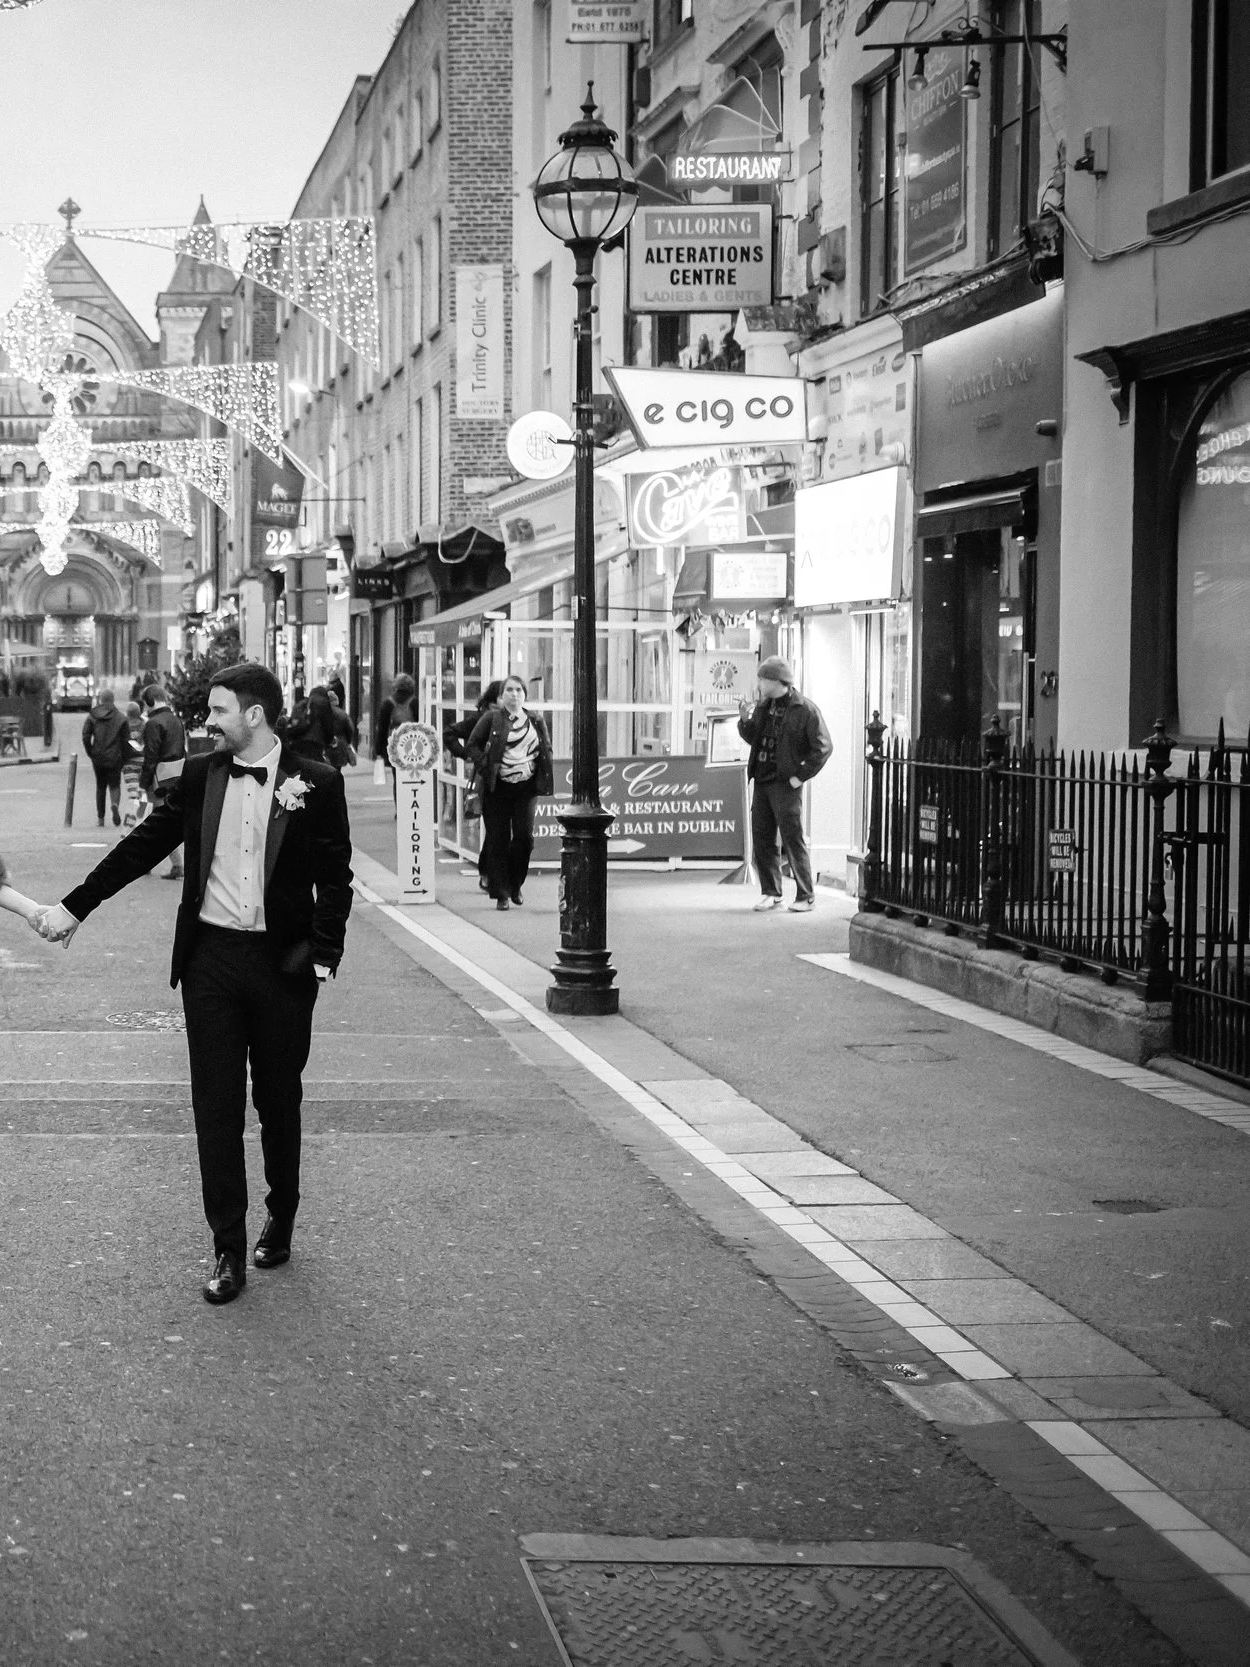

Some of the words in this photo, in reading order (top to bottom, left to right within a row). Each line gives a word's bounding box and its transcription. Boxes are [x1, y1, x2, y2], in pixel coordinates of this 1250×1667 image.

[910, 69, 960, 121] CHIFFON
[674, 156, 783, 180] RESTAURANT
[653, 217, 753, 236] TAILORING
[644, 244, 764, 265] ALTERATIONS
[669, 267, 738, 287] CENTRE
[643, 289, 695, 303] LADIES
[698, 289, 709, 303] &
[713, 289, 764, 303] GENTS
[471, 296, 487, 338] Clinic
[471, 343, 490, 392] Trinity
[643, 403, 665, 425] e
[675, 401, 734, 428] cig
[745, 397, 794, 420] co
[265, 529, 293, 557] 22
[357, 577, 390, 587] LINKS
[399, 732, 429, 748] ALTERATION
[403, 753, 426, 763] CENTRE
[621, 761, 700, 798] Cave
[534, 803, 568, 818] WIN
[624, 799, 724, 816] RESTAURANT
[410, 788, 422, 886] TAILORING
[532, 823, 567, 839] LDES
[623, 822, 654, 835] BAR
[657, 821, 673, 835] IN
[677, 819, 736, 835] DUBLIN
[1050, 832, 1072, 844] BICYCLES
[1050, 845, 1063, 857] WILL
[1063, 845, 1071, 857] BE
